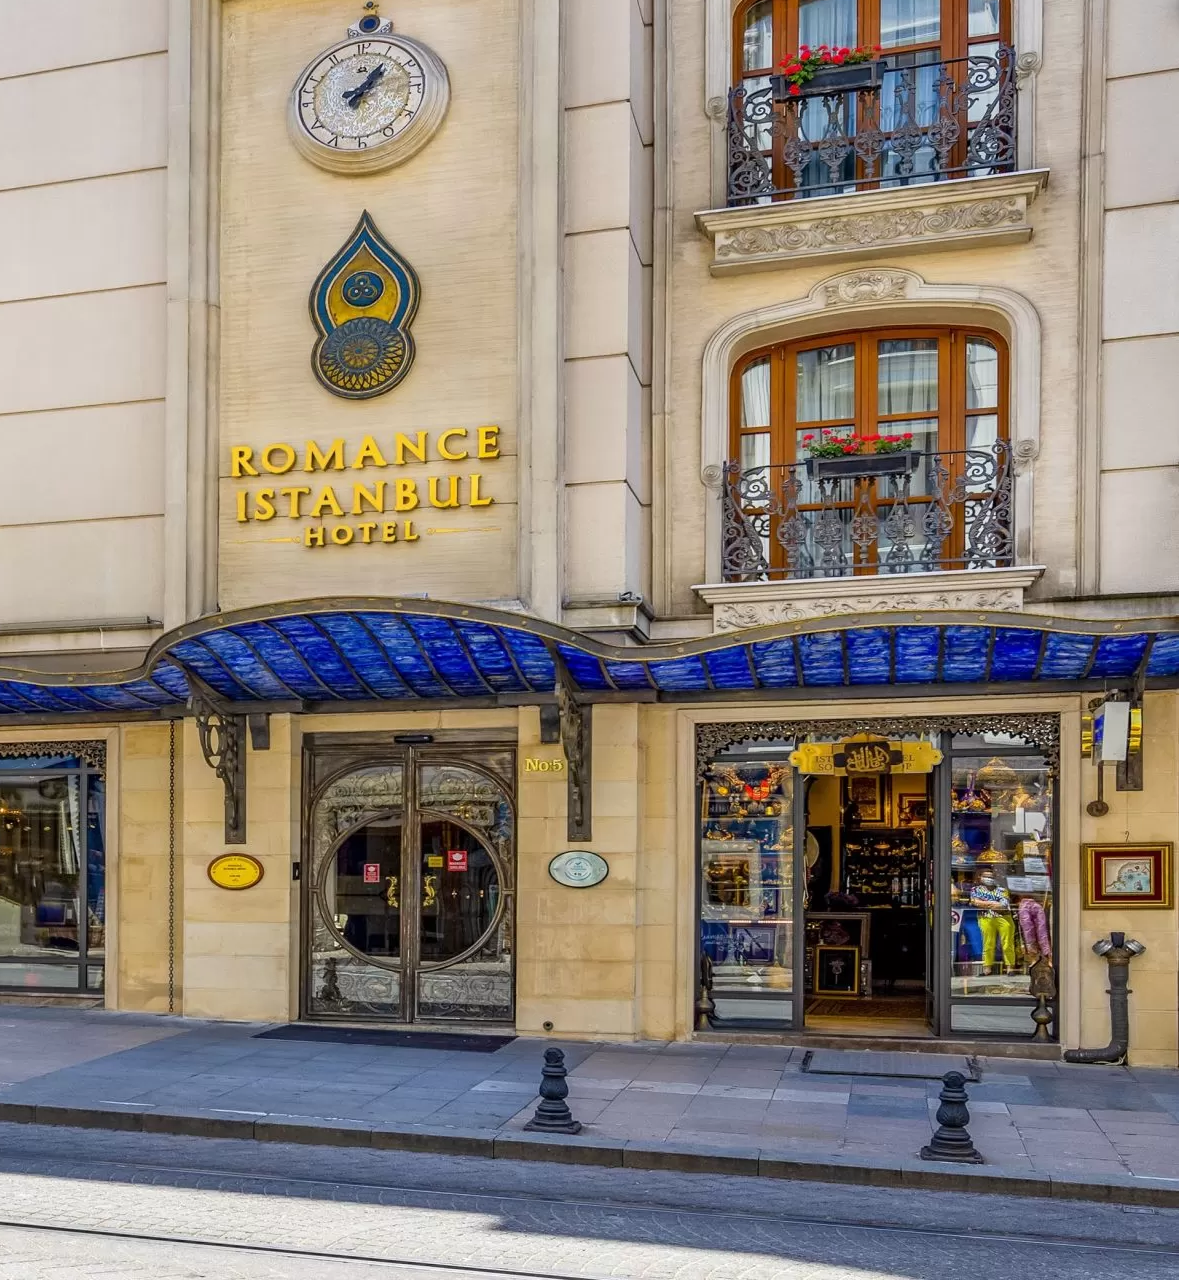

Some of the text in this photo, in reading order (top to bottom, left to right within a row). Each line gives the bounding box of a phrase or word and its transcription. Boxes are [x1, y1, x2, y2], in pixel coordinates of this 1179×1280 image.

[230, 425, 501, 478] ROMANCE
[235, 473, 495, 523] ISTANBUL
[303, 520, 420, 548] HOTEL
